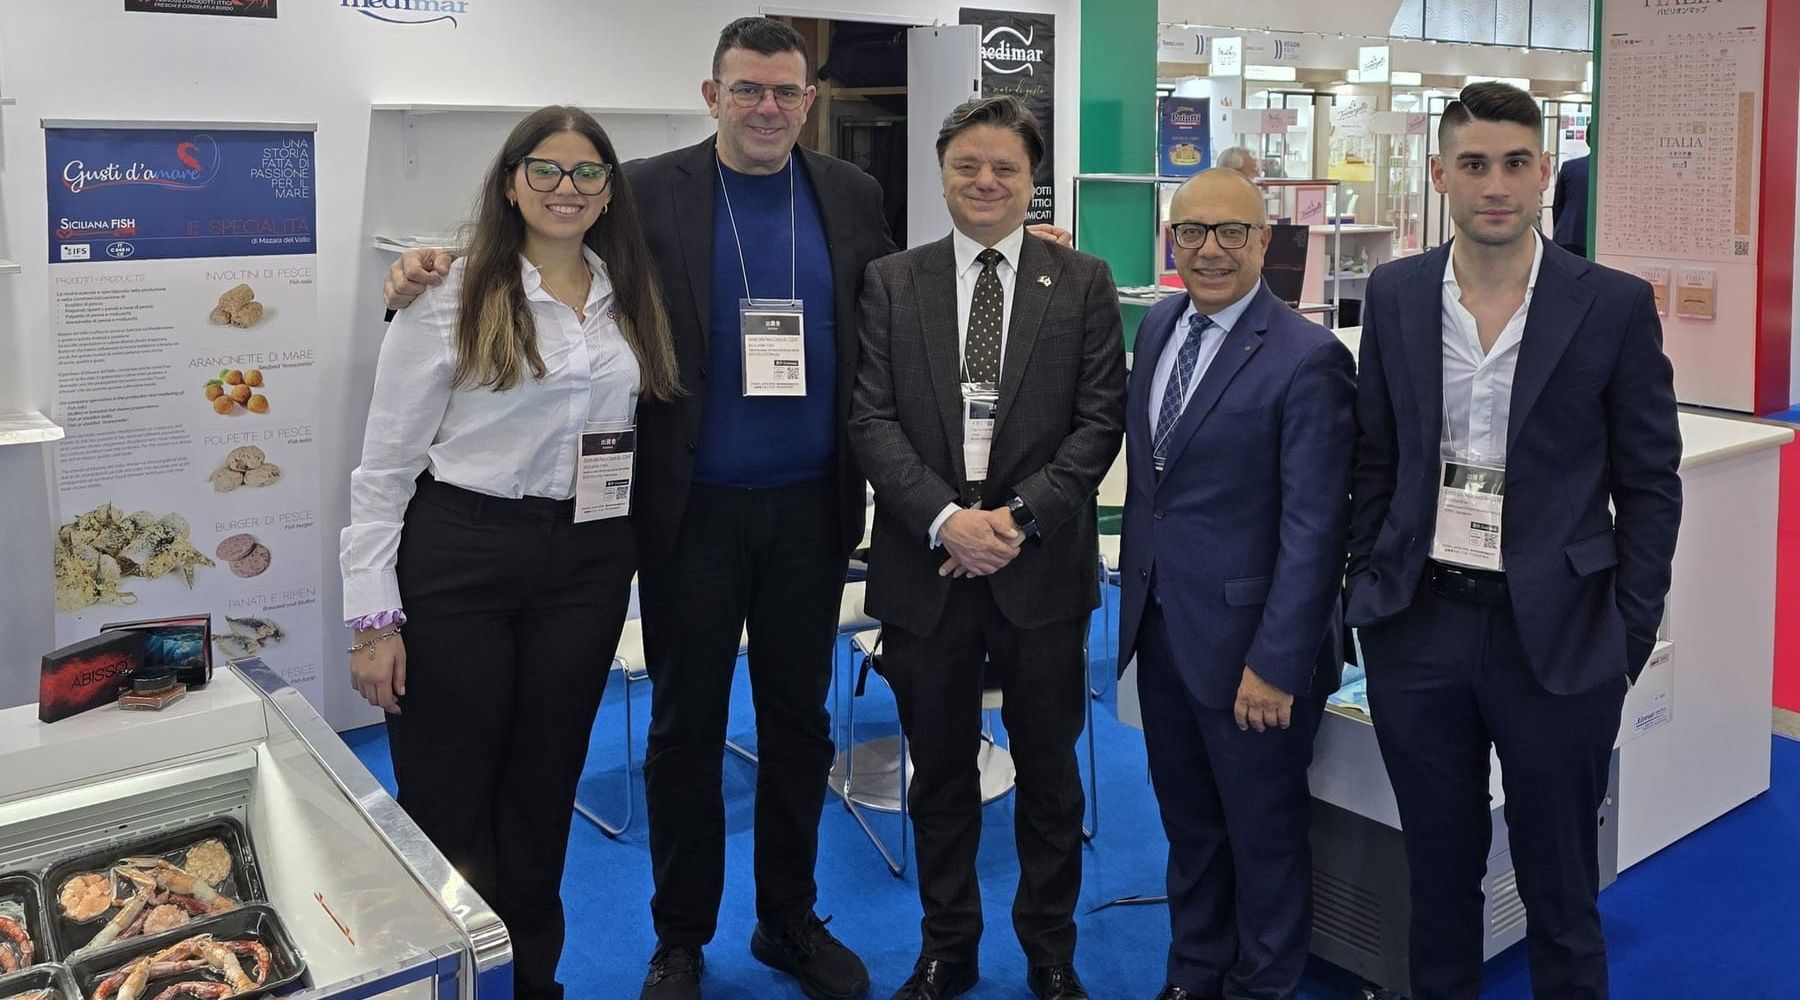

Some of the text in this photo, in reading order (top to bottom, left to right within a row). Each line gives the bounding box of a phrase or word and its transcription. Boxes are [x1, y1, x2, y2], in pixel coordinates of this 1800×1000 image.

[282, 138, 308, 148] UNA
[1658, 136, 1703, 148] ITALIA
[263, 148, 308, 158] STORIA
[262, 158, 309, 168] FATTA DI
[63, 160, 122, 193] Gusti
[250, 168, 309, 179] PASSIONE
[272, 179, 309, 188] PER IL
[276, 188, 309, 198] MARE
[1036, 186, 1052, 195] OTTI
[111, 219, 135, 228] FISH
[206, 267, 312, 280] INVOLTINI DI PESCE
[188, 349, 313, 368] ARANCINETTE DI MARE
[204, 425, 312, 446] POLPETTE DI PESCE
[216, 510, 313, 532] BURGER DI PESCE
[72, 660, 128, 689] ABISSO
